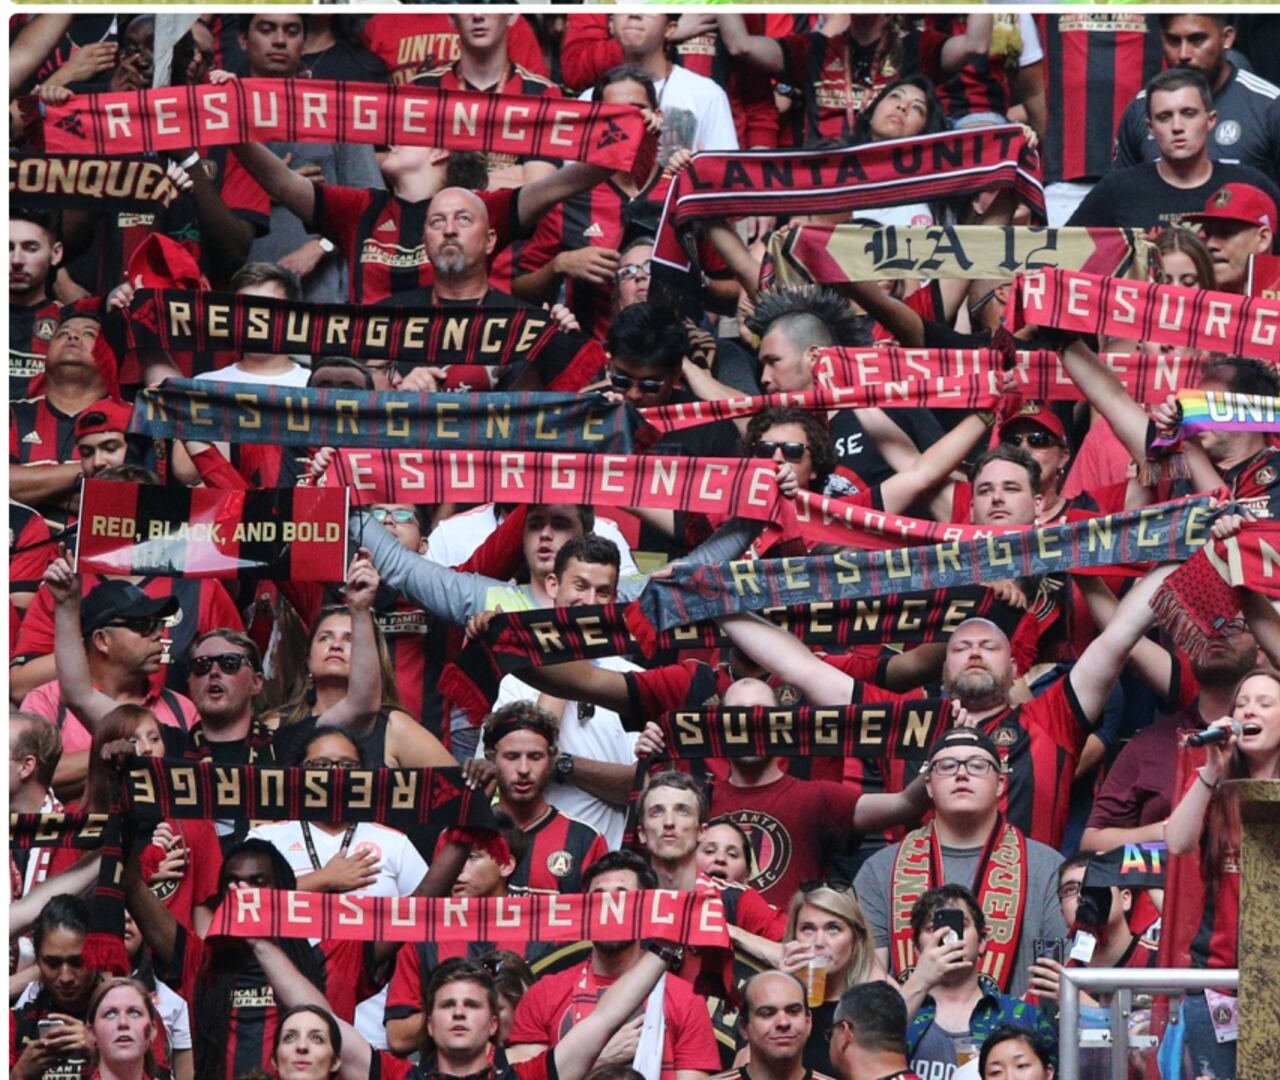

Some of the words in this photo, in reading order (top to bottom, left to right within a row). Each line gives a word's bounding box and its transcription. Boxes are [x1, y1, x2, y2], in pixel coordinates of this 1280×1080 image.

[104, 89, 581, 147] RESURGENCE
[864, 224, 974, 272] LA
[170, 300, 546, 357] RESURGENCE
[145, 387, 606, 442] RESURGENCE
[348, 451, 777, 506] ESURGENCE
[91, 515, 141, 541] RED,
[148, 519, 226, 545] BLACK,
[232, 521, 277, 542] AND
[282, 521, 341, 543] BOLD
[729, 508, 1209, 597] RESURGENCE
[675, 709, 934, 748] SURGEN
[237, 888, 726, 933] RESURGENCE
